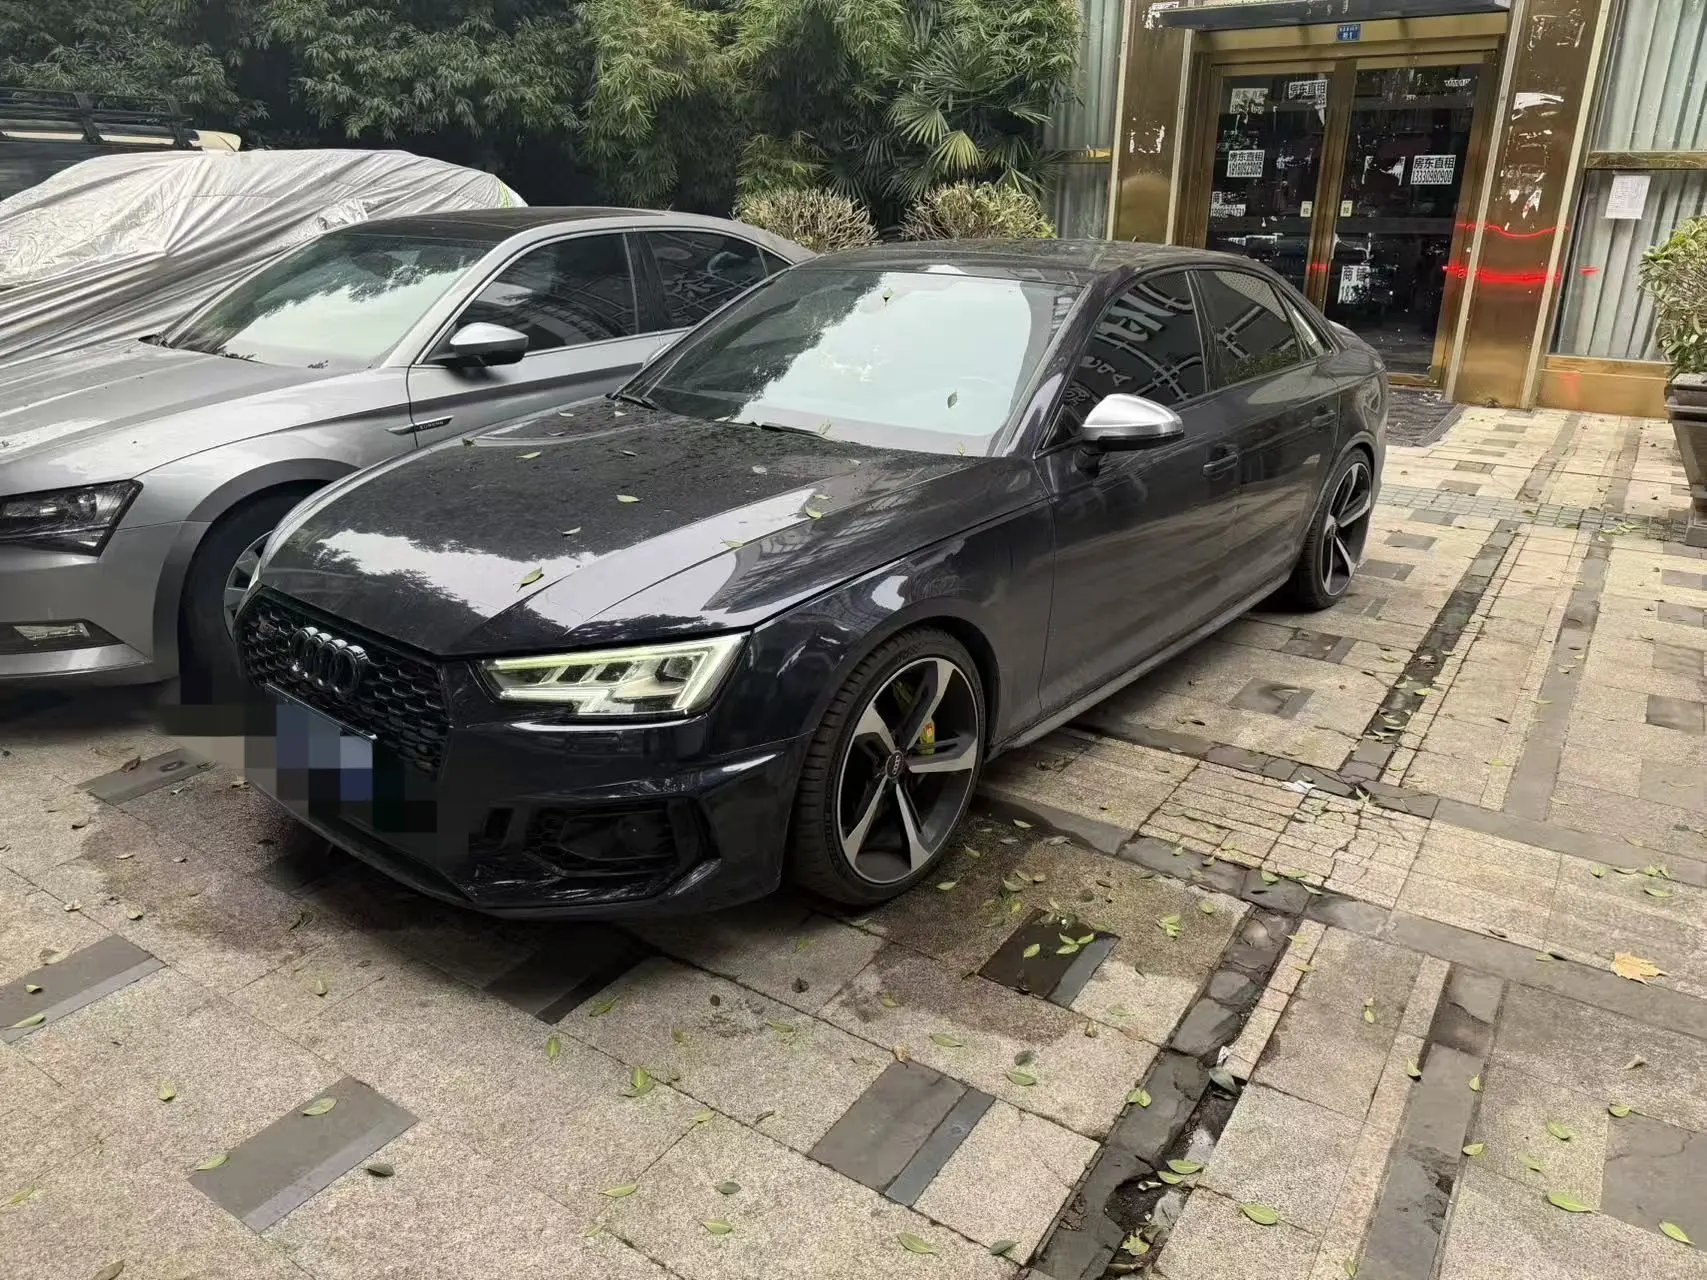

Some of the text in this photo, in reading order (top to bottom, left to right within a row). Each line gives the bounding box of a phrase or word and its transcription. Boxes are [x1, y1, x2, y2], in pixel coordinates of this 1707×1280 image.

[1229, 151, 1263, 162] 房东直租
[1414, 157, 1454, 169] 房东直租
[1412, 169, 1453, 184] 13330980900
